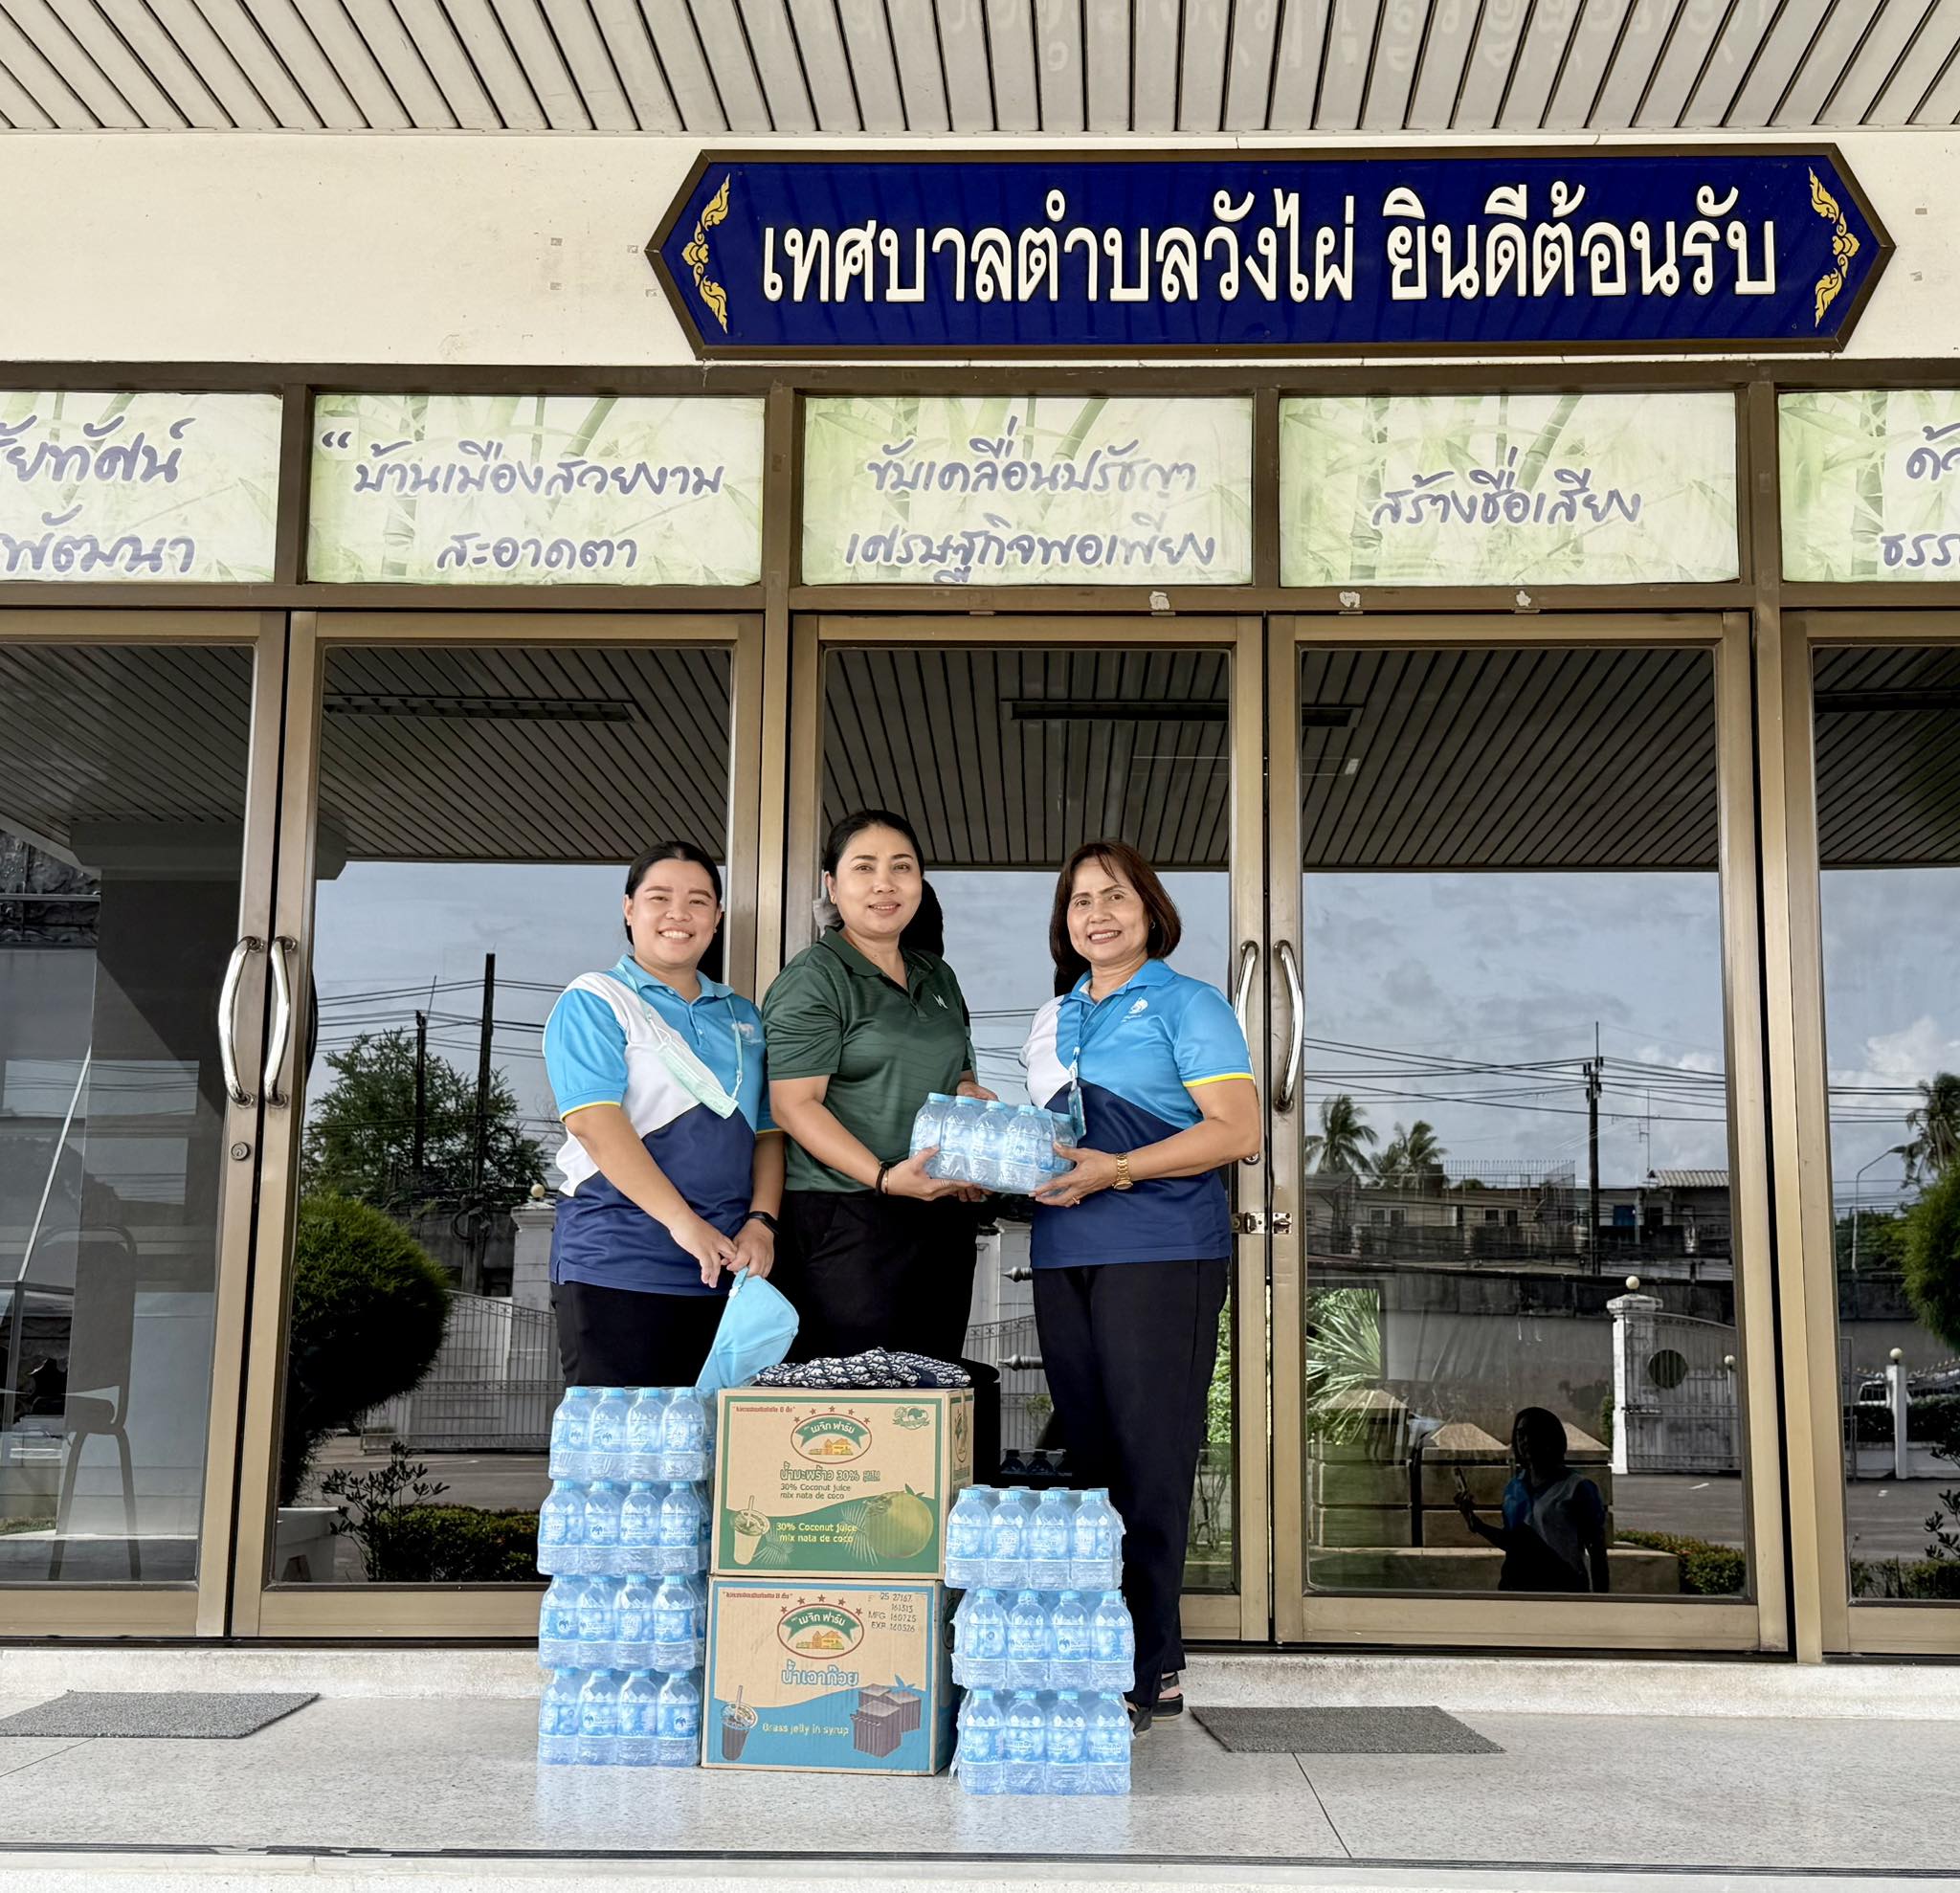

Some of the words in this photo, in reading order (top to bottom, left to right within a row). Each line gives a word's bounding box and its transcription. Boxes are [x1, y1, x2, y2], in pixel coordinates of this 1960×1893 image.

[765, 189, 1354, 302] เทศบาลตำบลวังไผ่
[1383, 181, 1776, 300] ยินดีต้อนรับ
[0, 415, 195, 483] ัยทัศน์
[353, 440, 724, 496] บ้านเมืองสวยงาม
[867, 415, 1196, 499] ขับเคลื่อนปรัชญา
[1372, 446, 1641, 523] สร้างชื่อเสียง
[0, 504, 195, 572] พัฒนา
[436, 532, 637, 569] สะอาดตา
[845, 511, 1214, 583] เศรษฐกิจพอเพียง
[1880, 533, 1960, 567] ธรร
[835, 1469, 860, 1481] 30%
[776, 1523, 796, 1531] 30%
[798, 1523, 834, 1531] Coconut
[819, 1534, 830, 1543] de
